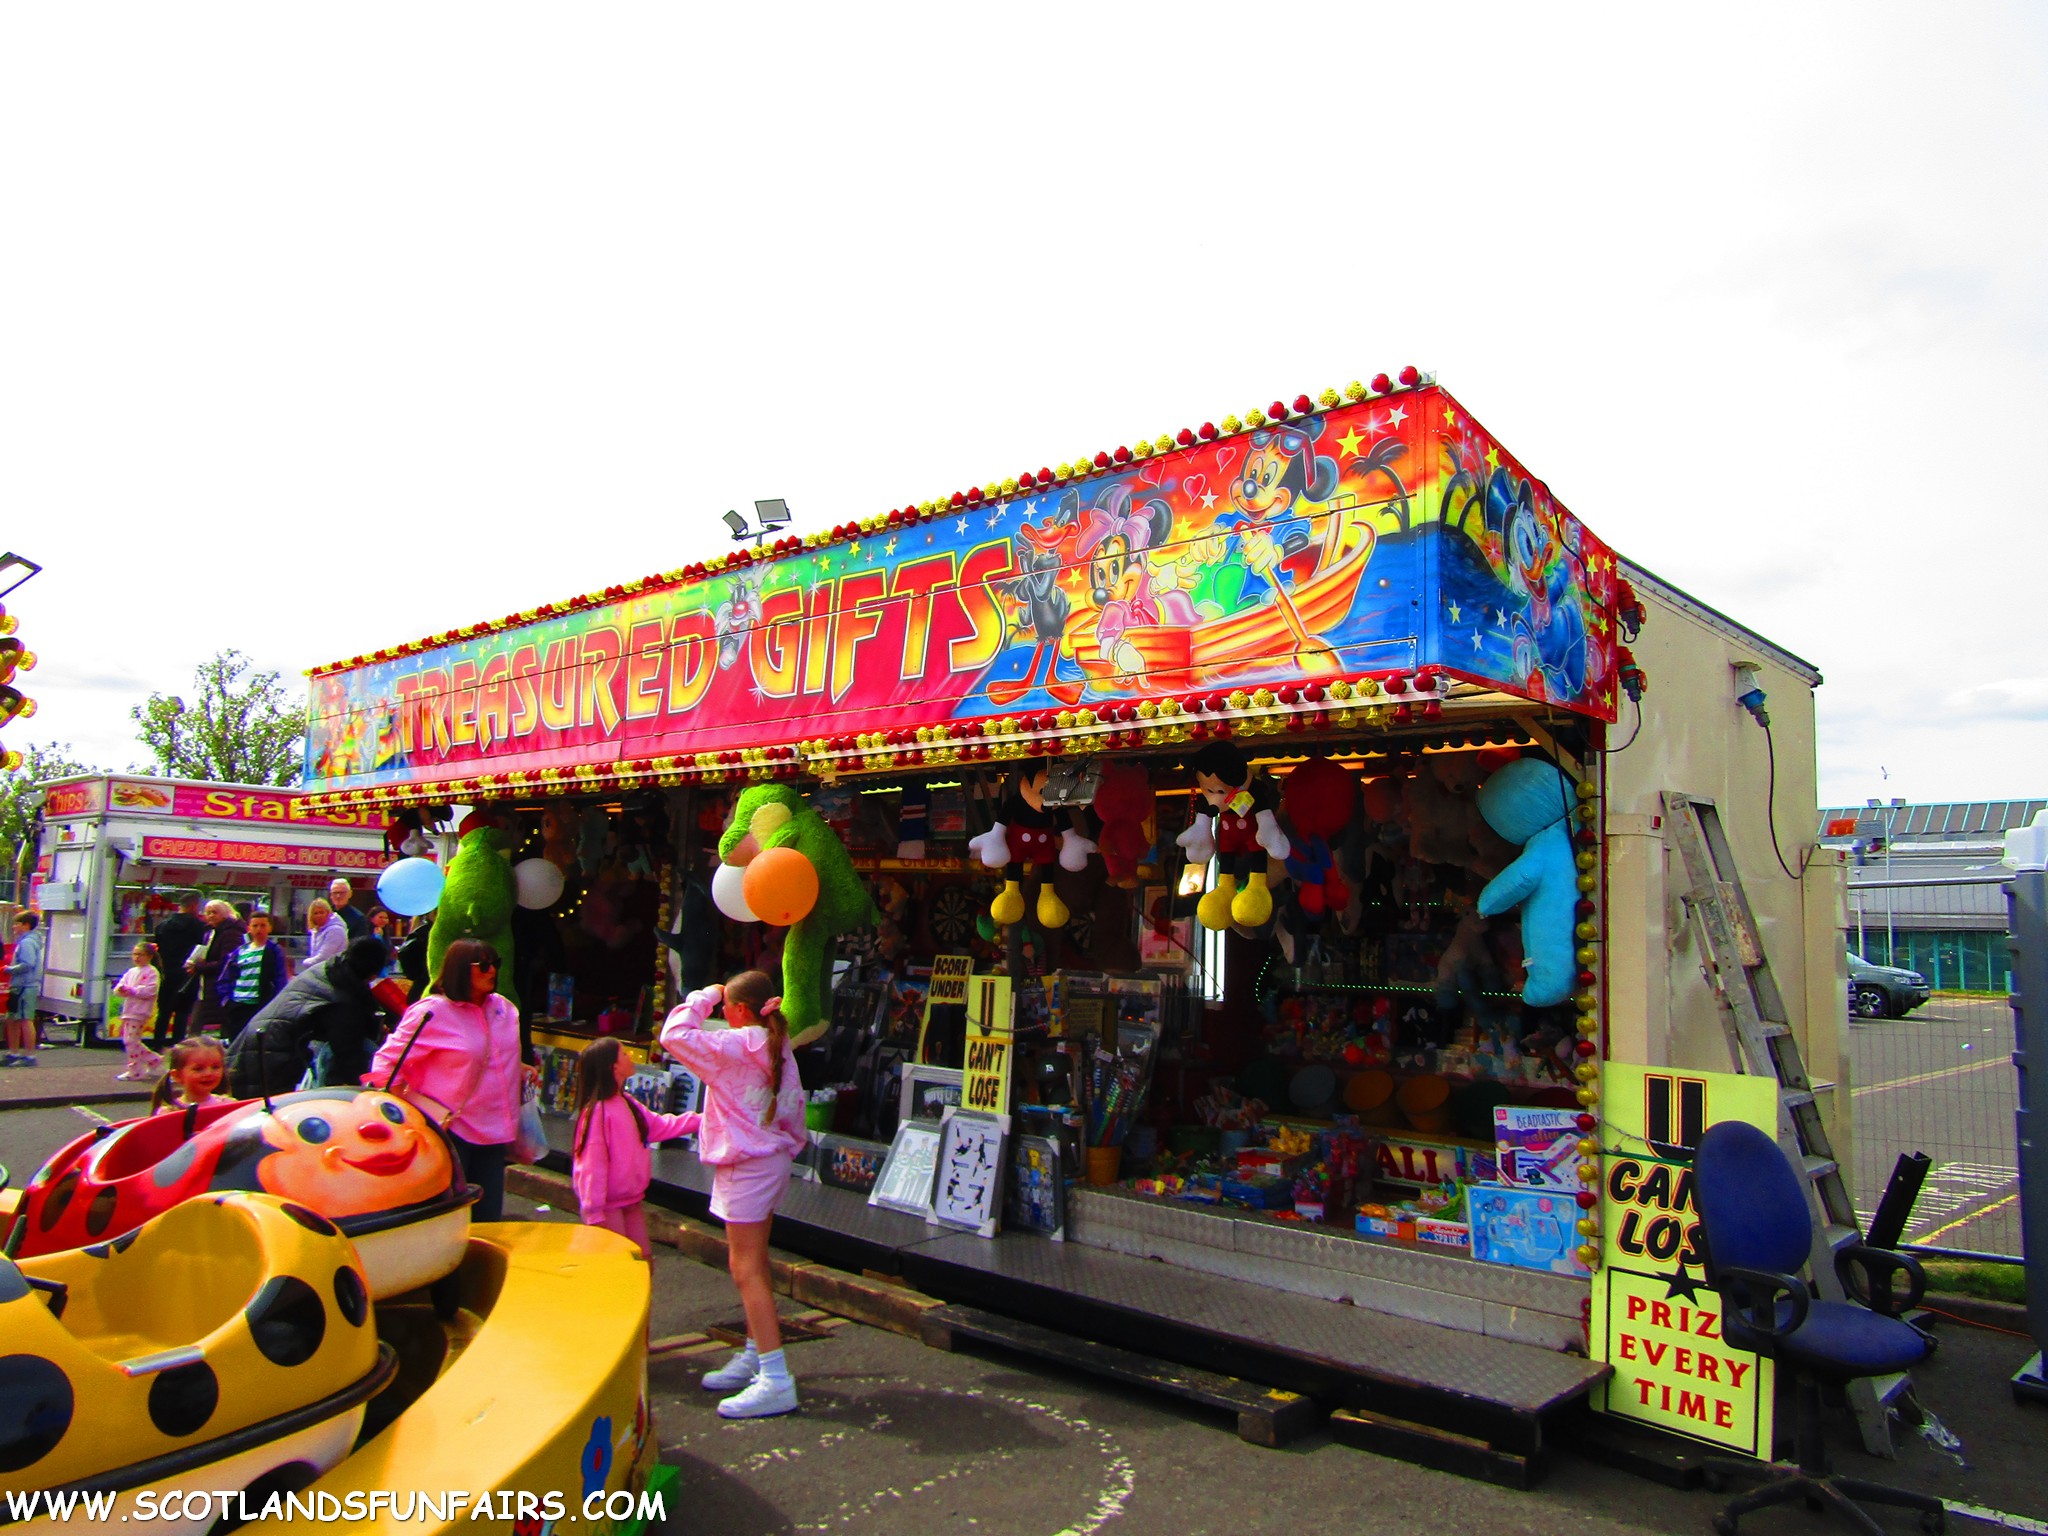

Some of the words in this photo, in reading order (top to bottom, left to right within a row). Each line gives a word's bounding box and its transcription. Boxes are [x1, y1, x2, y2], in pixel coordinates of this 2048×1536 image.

[393, 617, 721, 757] TREASURED
[747, 536, 1013, 704] GIFTS
[149, 838, 218, 859] CHEESE
[223, 842, 288, 863] BURGER
[299, 848, 332, 865] HOT
[335, 850, 367, 866] DOG
[930, 979, 964, 999] UNDER
[934, 956, 967, 977] SCORE
[968, 1041, 1005, 1073] CAN'T
[968, 1075, 1001, 1109] LOSE
[1644, 1073, 1707, 1162] U
[1607, 1158, 1701, 1216] CAN
[1616, 1208, 1706, 1269] LOS
[1626, 1293, 1722, 1341] PRIZ
[1618, 1333, 1751, 1389] EVERY
[1633, 1377, 1735, 1430] TIME
